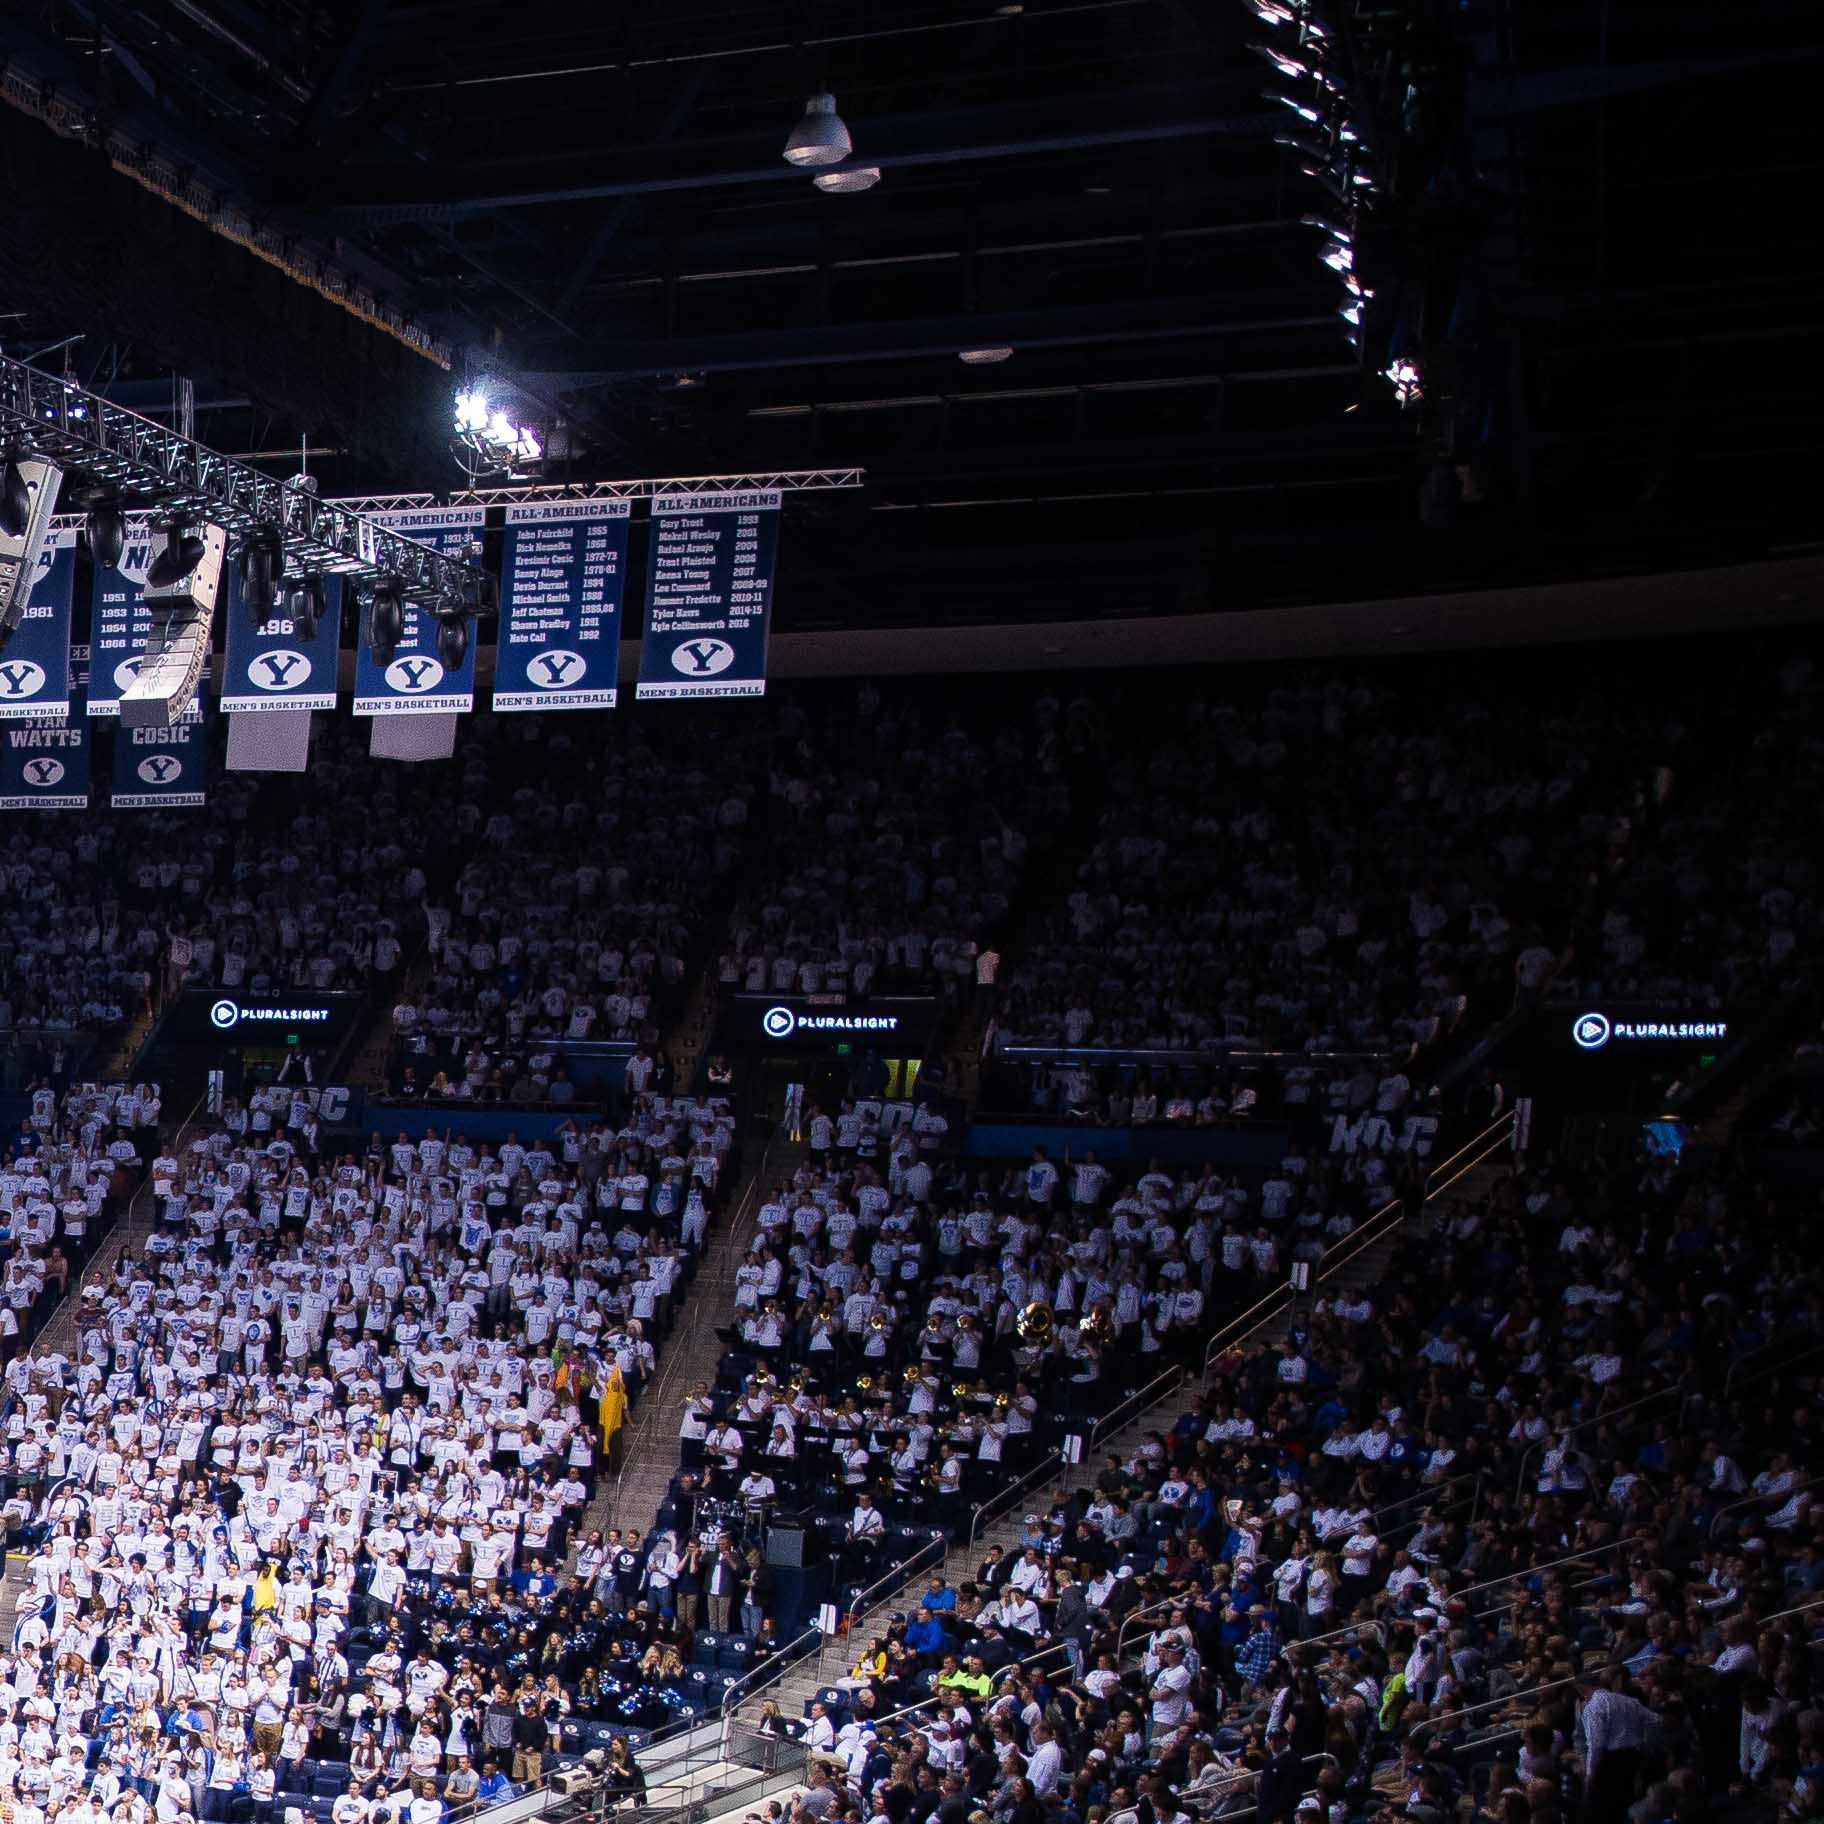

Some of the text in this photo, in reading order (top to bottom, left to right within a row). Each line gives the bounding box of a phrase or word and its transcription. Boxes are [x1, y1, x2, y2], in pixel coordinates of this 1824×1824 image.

[658, 494, 778, 510] ALL-AMERICANS
[511, 503, 628, 520] ALL-AMERICANS
[22, 606, 54, 618] 1981
[638, 686, 762, 698] MEN'S BASKETBALL
[222, 699, 334, 711] MEN'S BASKETBALL
[355, 698, 470, 710] MEN'S BASKETBALL
[495, 693, 614, 706] MEN'S BASKETBALL
[0, 706, 67, 717] BASKETBALL
[9, 729, 83, 748] WATTS
[131, 725, 191, 745] COSIC
[240, 1008, 329, 1020] PLURALSIGHT
[797, 1016, 898, 1030] PLURALSIGHT
[1614, 1023, 1728, 1038] PLURALSIGHT
